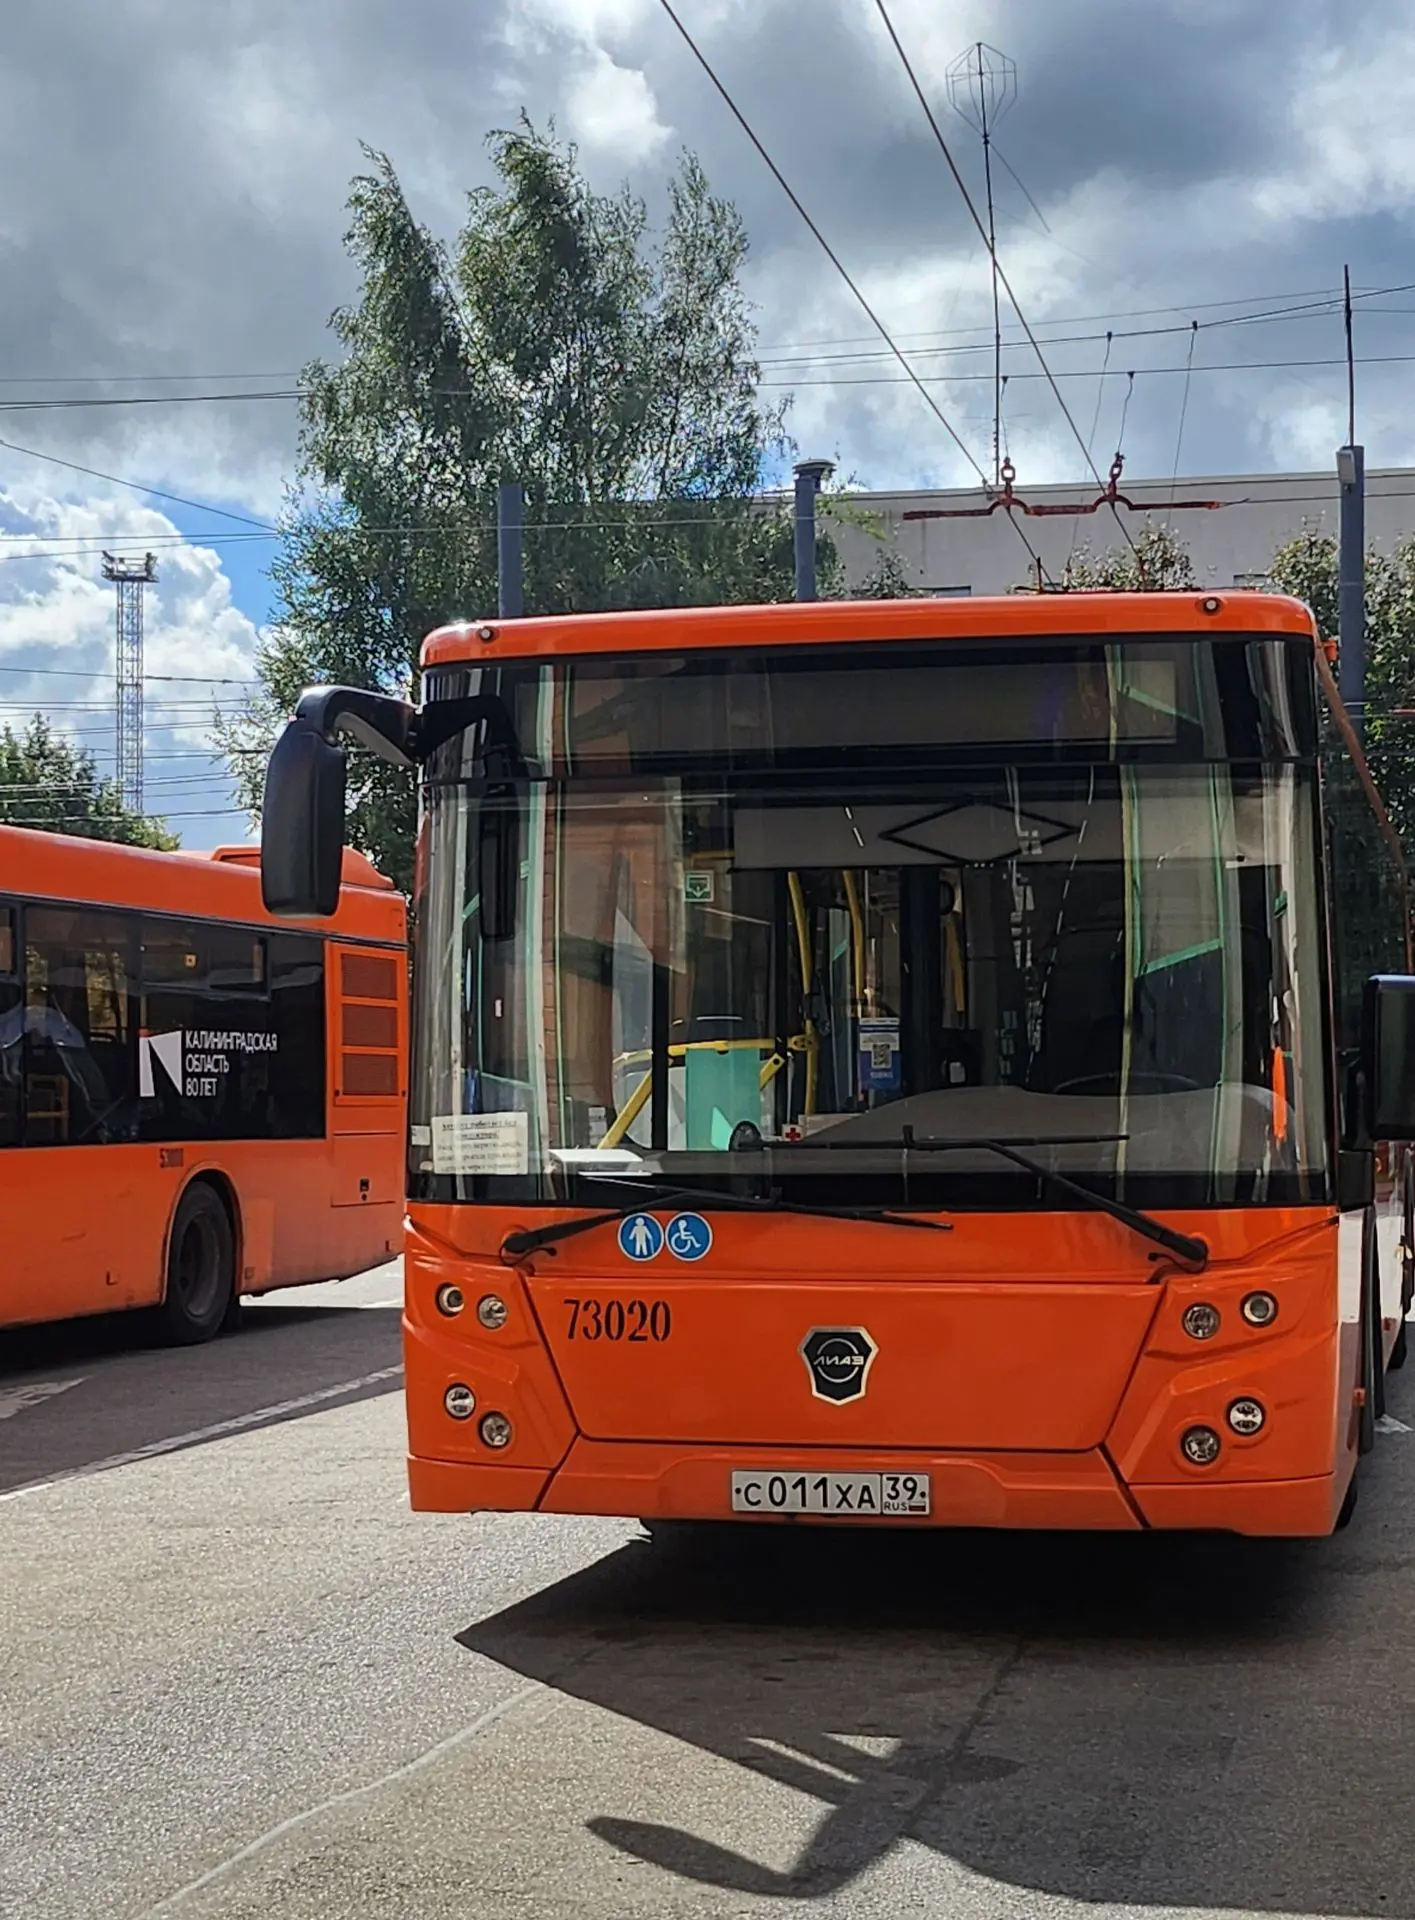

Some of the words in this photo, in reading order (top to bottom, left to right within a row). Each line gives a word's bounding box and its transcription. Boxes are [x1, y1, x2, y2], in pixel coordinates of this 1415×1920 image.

[185, 1030, 278, 1054] КАЛИНИНГРАДСКАЯ
[185, 1053, 230, 1073] ОБЛАСТЬ
[186, 1078, 199, 1096] 80
[199, 1078, 218, 1096] ЛЕТ
[563, 1299, 671, 1341] 73020
[886, 1477, 918, 1501] 39
[883, 1502, 908, 1511] RUS
